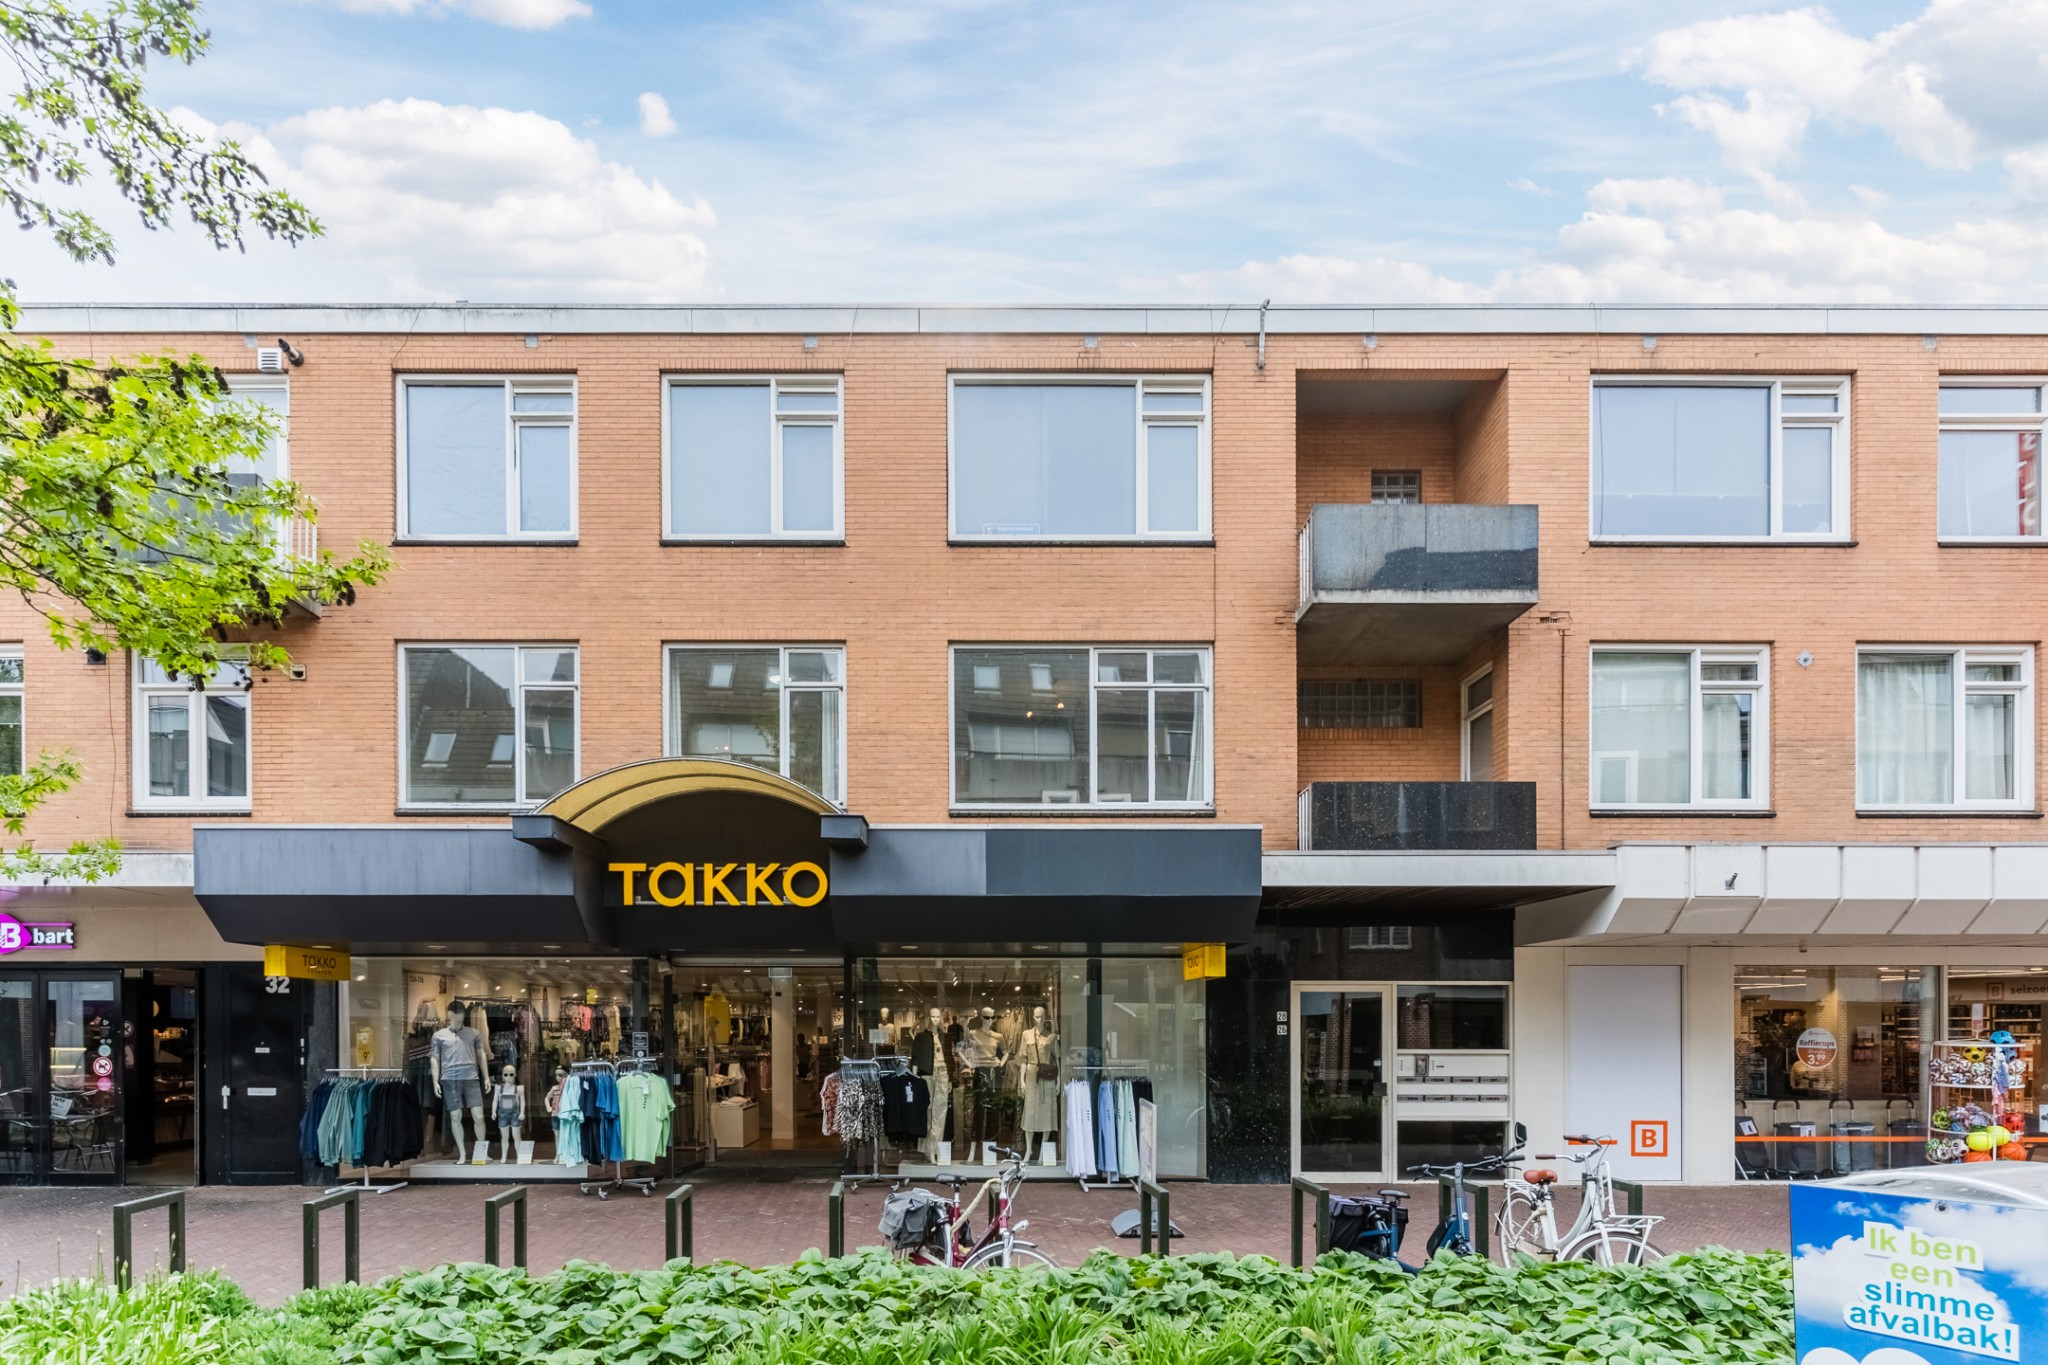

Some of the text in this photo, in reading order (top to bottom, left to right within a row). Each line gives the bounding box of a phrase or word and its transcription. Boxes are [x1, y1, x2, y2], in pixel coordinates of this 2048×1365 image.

[33, 928, 74, 944] bart
[265, 976, 290, 994] 32
[2010, 985, 2048, 995] seizoe
[1278, 1012, 1287, 1021] 28
[1799, 1039, 1836, 1048] Koffiecups
[1641, 1129, 1657, 1148] B
[1869, 1227, 1977, 1264] Ik ben
[1890, 1262, 1953, 1288] een
[1864, 1281, 1995, 1322] slimme
[1849, 1304, 2012, 1353] afvalbak!
